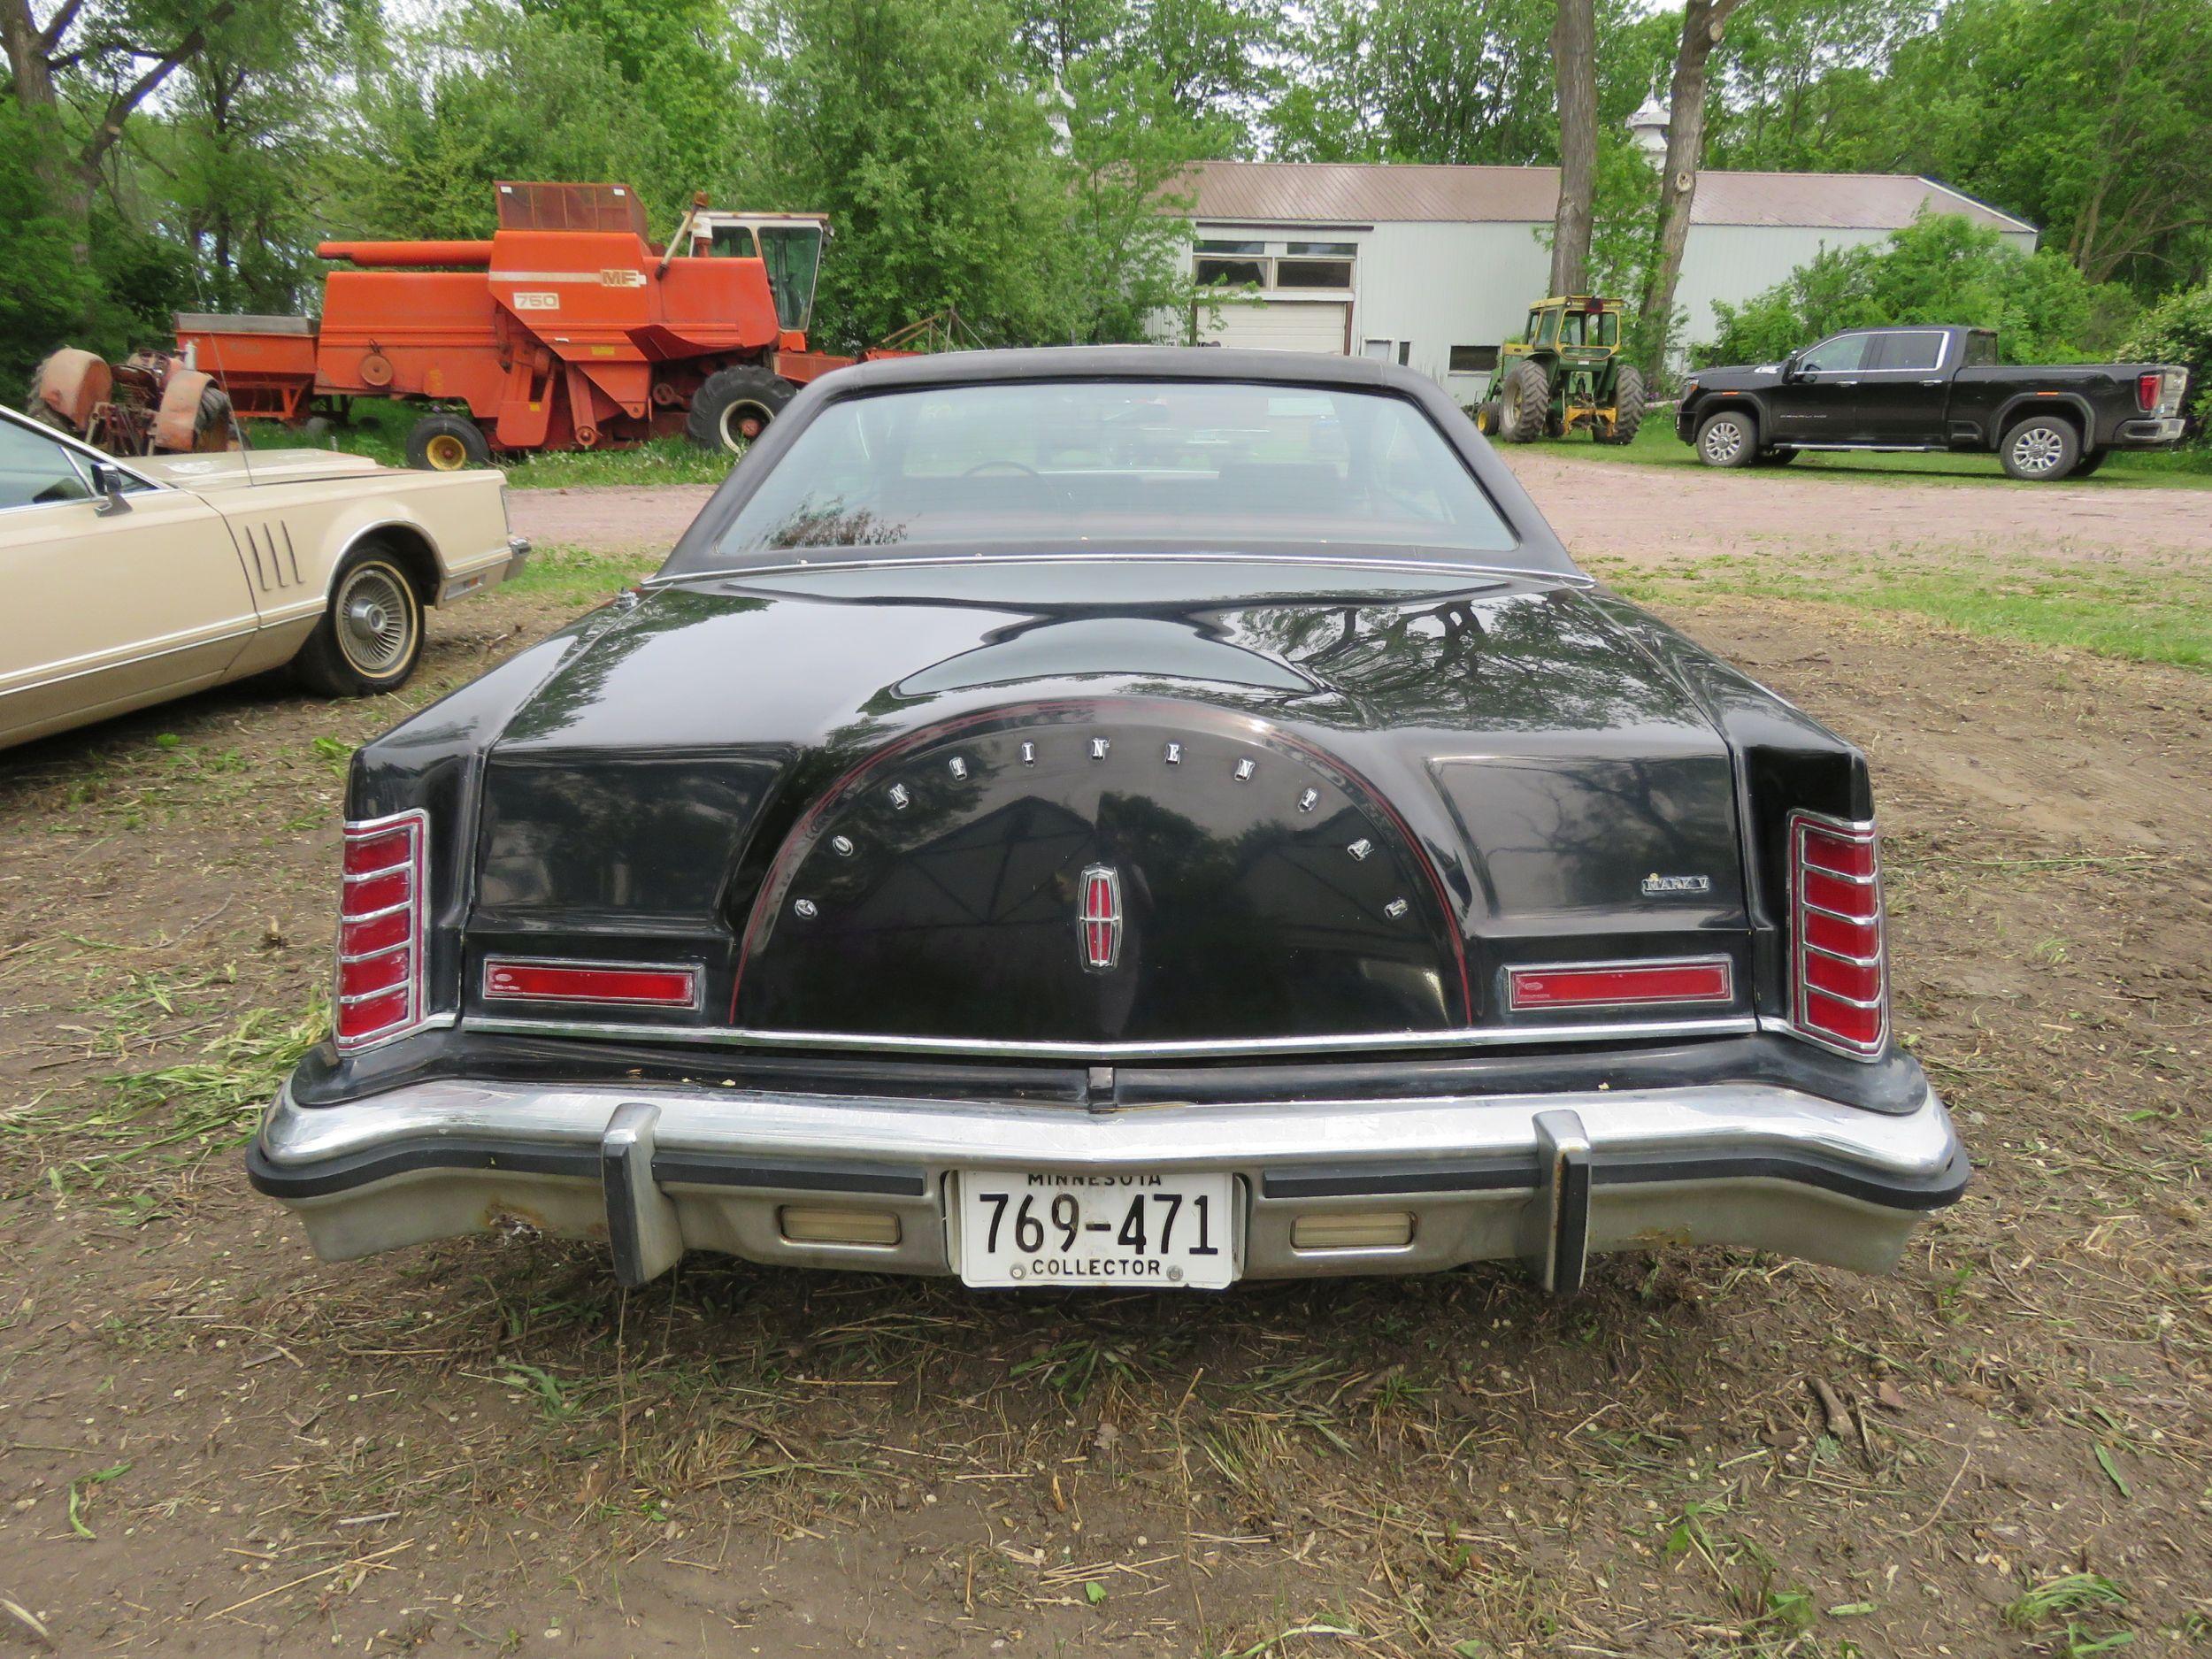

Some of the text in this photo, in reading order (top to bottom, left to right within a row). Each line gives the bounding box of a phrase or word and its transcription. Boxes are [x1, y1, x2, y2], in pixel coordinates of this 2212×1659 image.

[603, 271, 637, 285] MF
[516, 295, 557, 307] 750
[795, 736, 1409, 920] CONTINENTAL
[1644, 877, 1709, 891] MARK V
[979, 1194, 1218, 1255] 769-471
[1032, 1259, 1161, 1275] COLLECTOR
